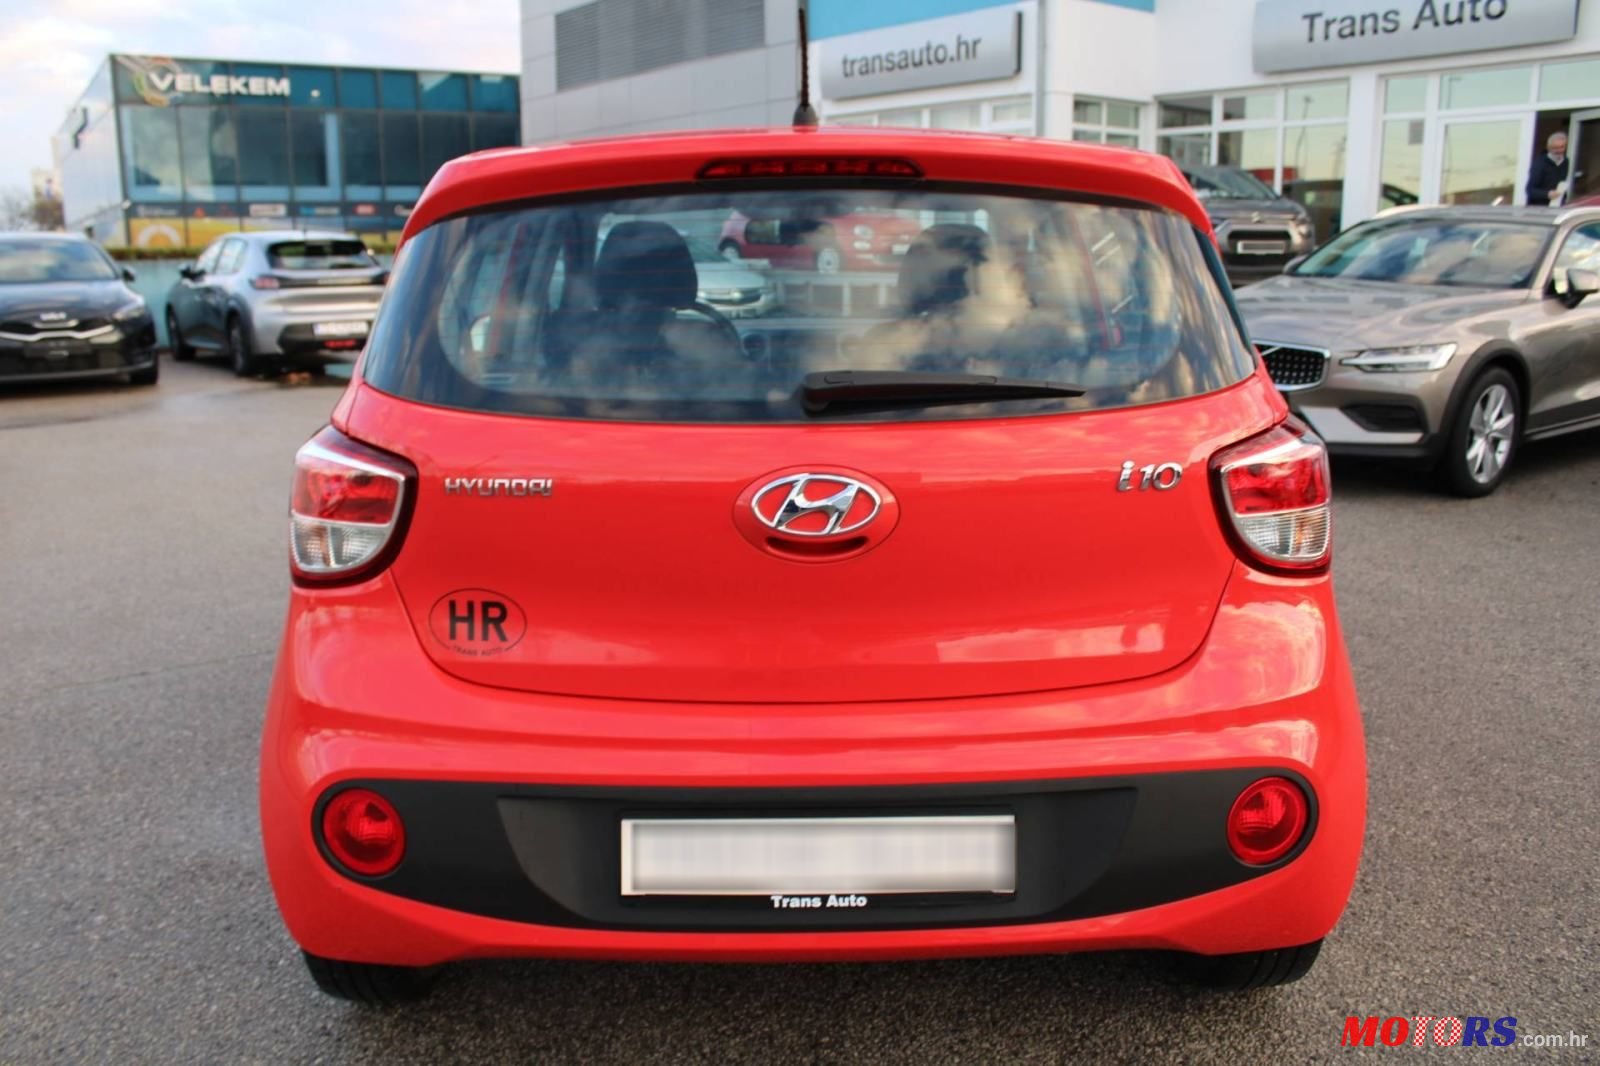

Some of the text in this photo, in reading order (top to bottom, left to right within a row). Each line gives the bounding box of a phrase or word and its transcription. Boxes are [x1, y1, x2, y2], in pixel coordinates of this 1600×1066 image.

[1302, 0, 1506, 43] Trans Auto
[841, 34, 982, 78] transauto.hr
[149, 72, 291, 96] VELEKEM
[444, 477, 553, 496] HYUNDAI
[1117, 460, 1183, 491] i10
[448, 600, 508, 642] HR
[771, 894, 867, 908] Trans Auto
